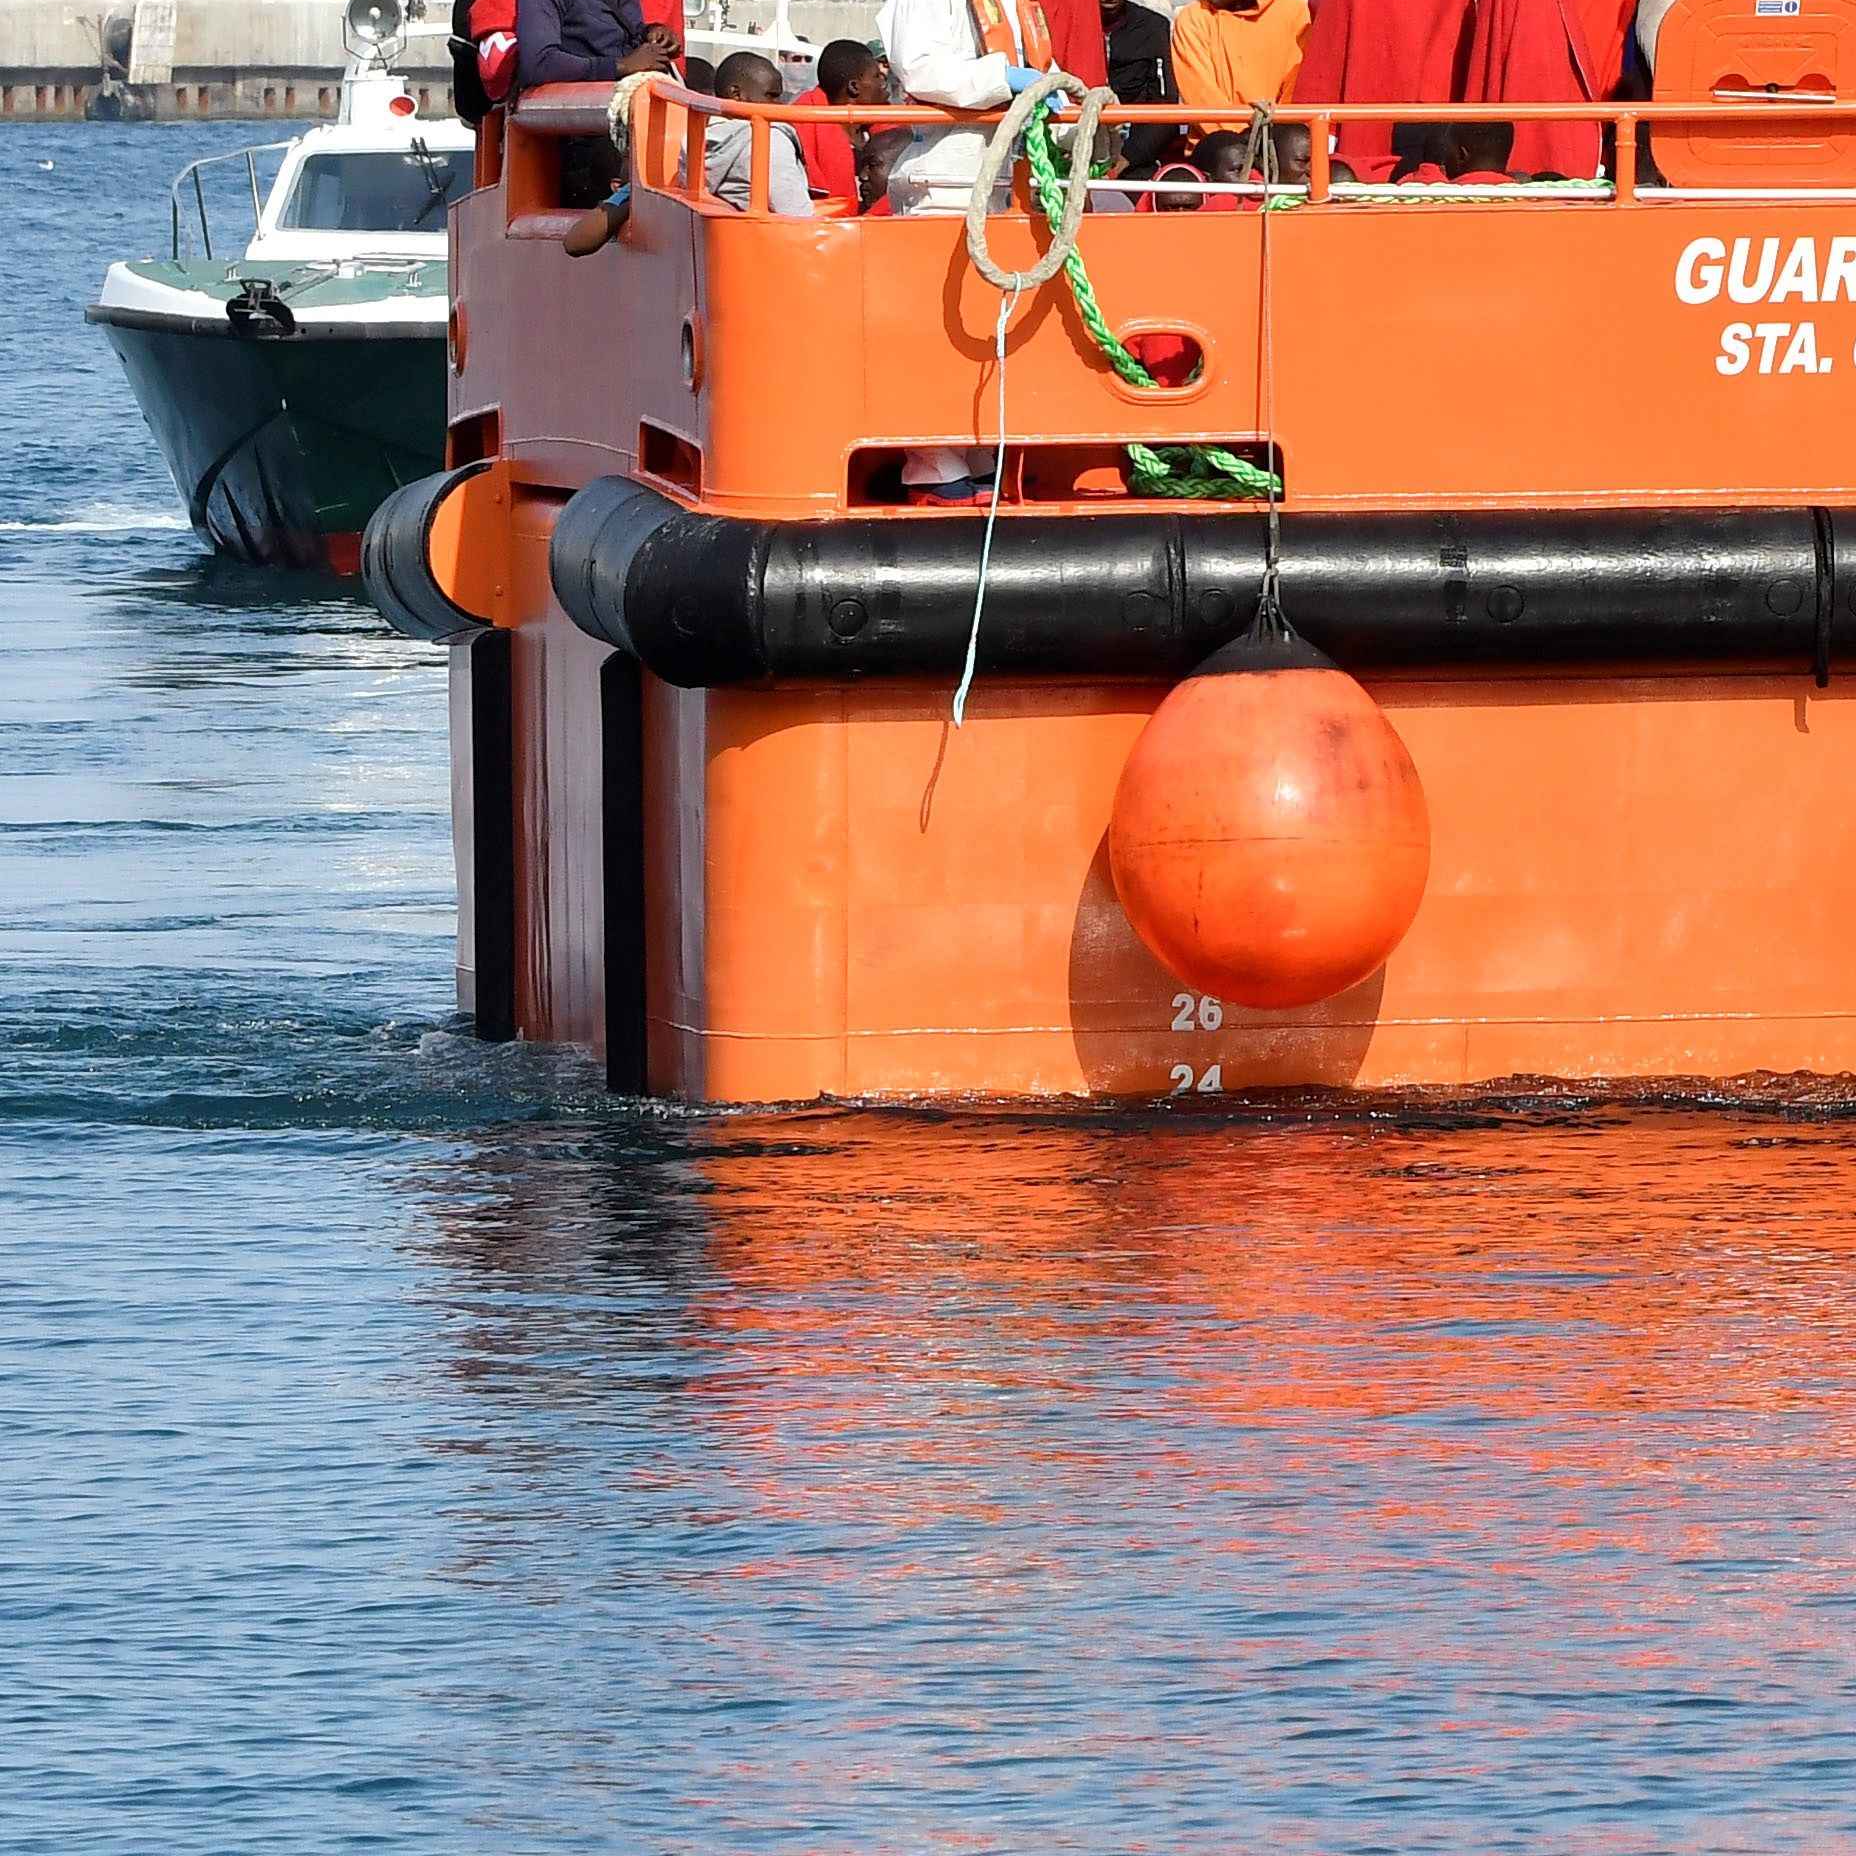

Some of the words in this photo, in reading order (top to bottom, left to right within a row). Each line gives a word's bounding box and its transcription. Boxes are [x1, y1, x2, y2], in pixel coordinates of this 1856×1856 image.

[1715, 322, 1833, 376] STA.
[1171, 992, 1223, 1032] 26
[1170, 1064, 1223, 1096] 24
